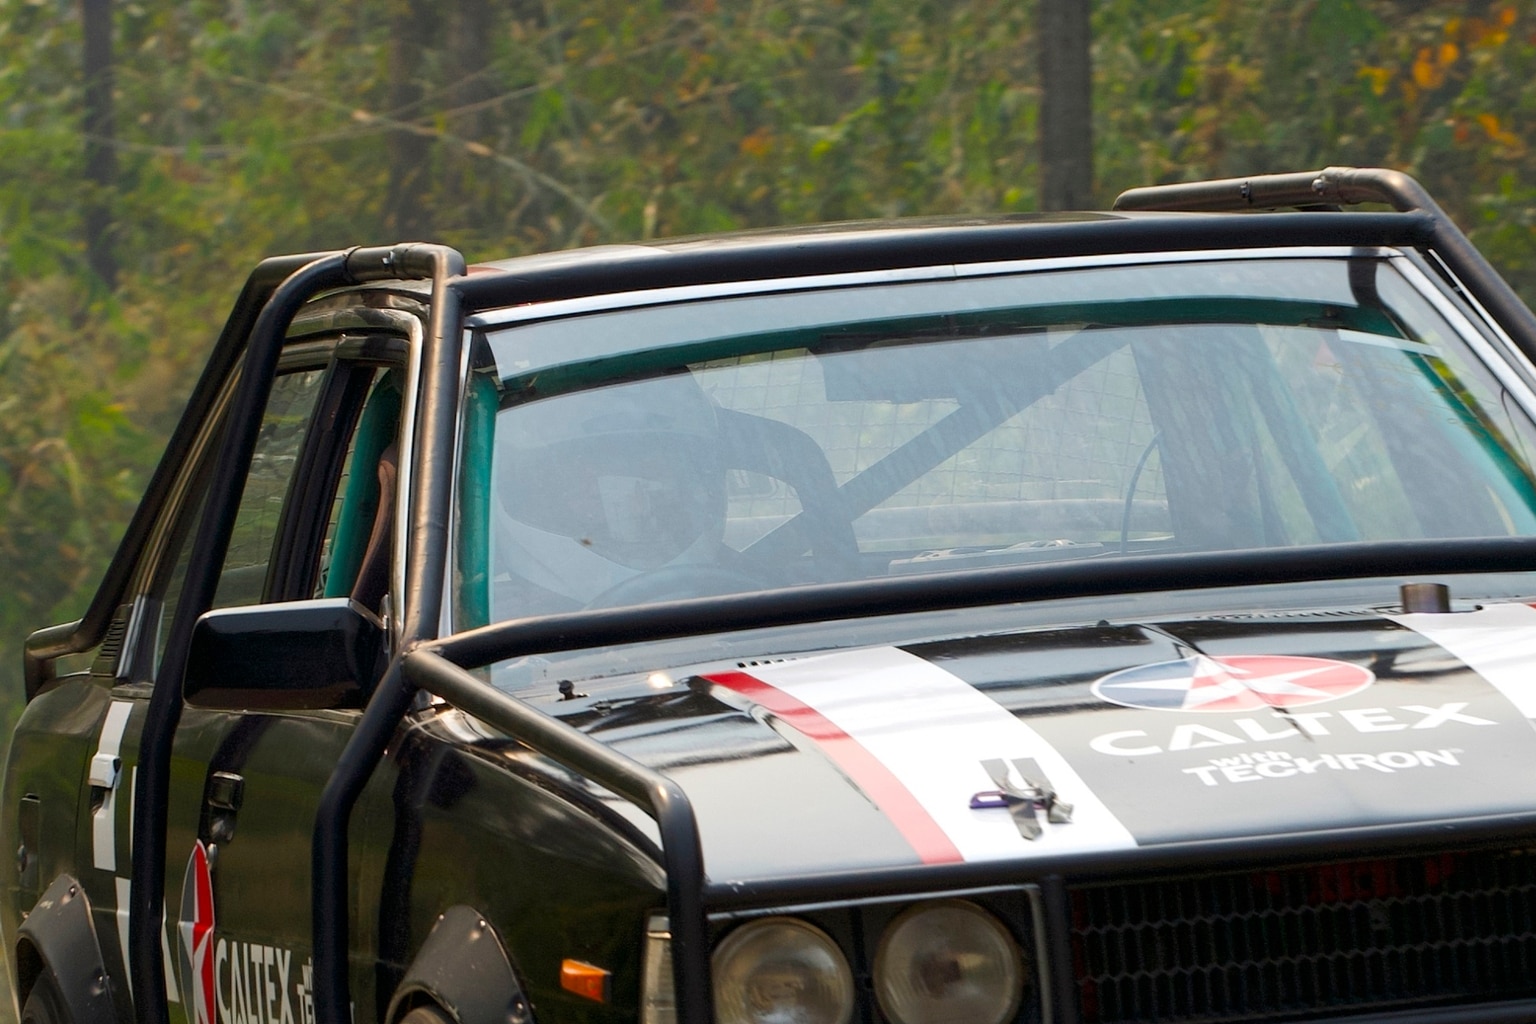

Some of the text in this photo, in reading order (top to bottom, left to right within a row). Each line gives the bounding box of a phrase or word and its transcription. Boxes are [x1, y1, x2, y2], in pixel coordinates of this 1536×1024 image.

[1089, 701, 1498, 757] CALTEX
[1181, 749, 1461, 787] TECHRON
[1208, 750, 1293, 768] with
